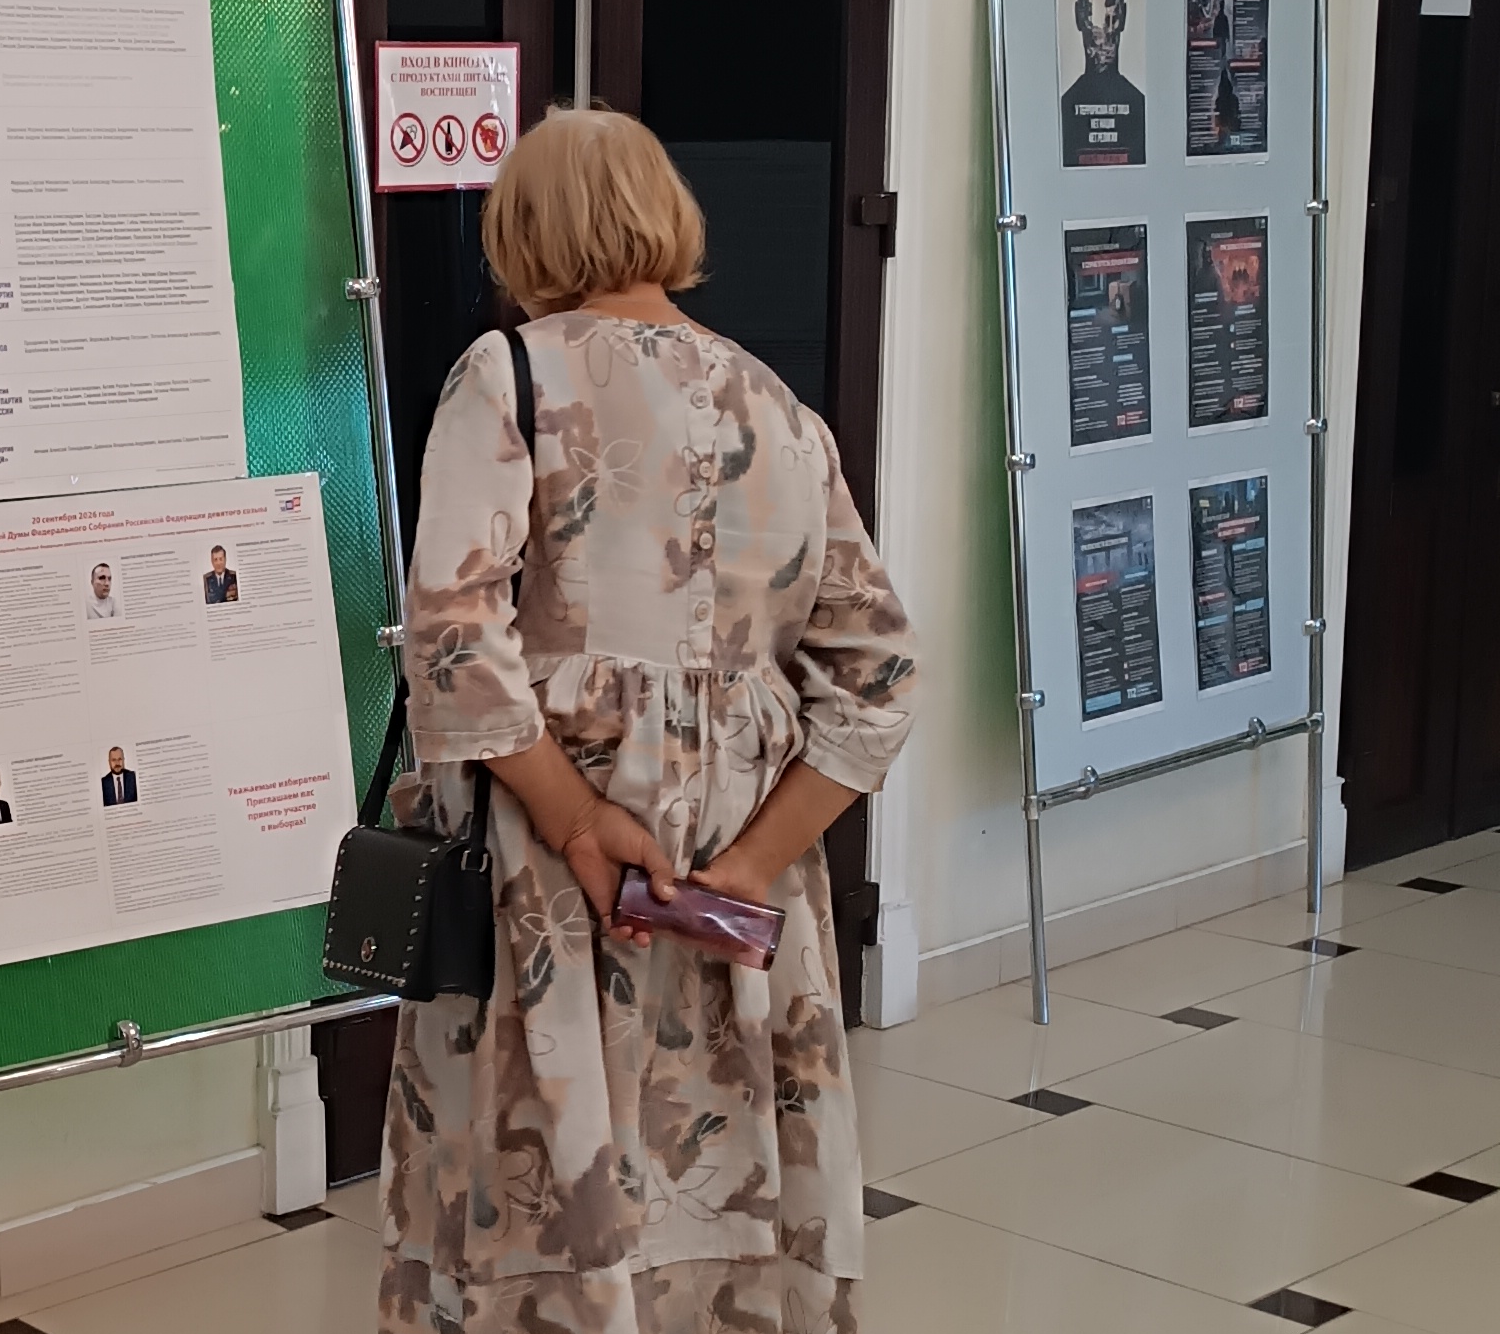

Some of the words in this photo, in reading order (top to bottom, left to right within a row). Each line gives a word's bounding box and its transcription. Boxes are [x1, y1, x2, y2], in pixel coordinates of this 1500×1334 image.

[401, 57, 430, 68] ВХОД
[434, 57, 440, 67] В
[391, 73, 397, 82] С
[399, 73, 460, 83] ПРОДУКТАМИ
[463, 73, 505, 82] ПИТАИ
[420, 87, 476, 97] ВОСПРЕЩЕН
[42, 513, 76, 523] сентября
[79, 511, 97, 519] 2026
[7, 530, 29, 540] Думы
[31, 525, 87, 536] Федерального
[89, 522, 124, 531] Собрания
[166, 512, 206, 523] Федерации
[207, 509, 241, 519] девятого
[228, 782, 276, 796] Уважаемые
[278, 772, 330, 787] избиратели!
[246, 792, 299, 807] Приглашаем
[248, 810, 282, 821] принять
[284, 803, 316, 816] участие
[268, 817, 306, 829] выборах!
